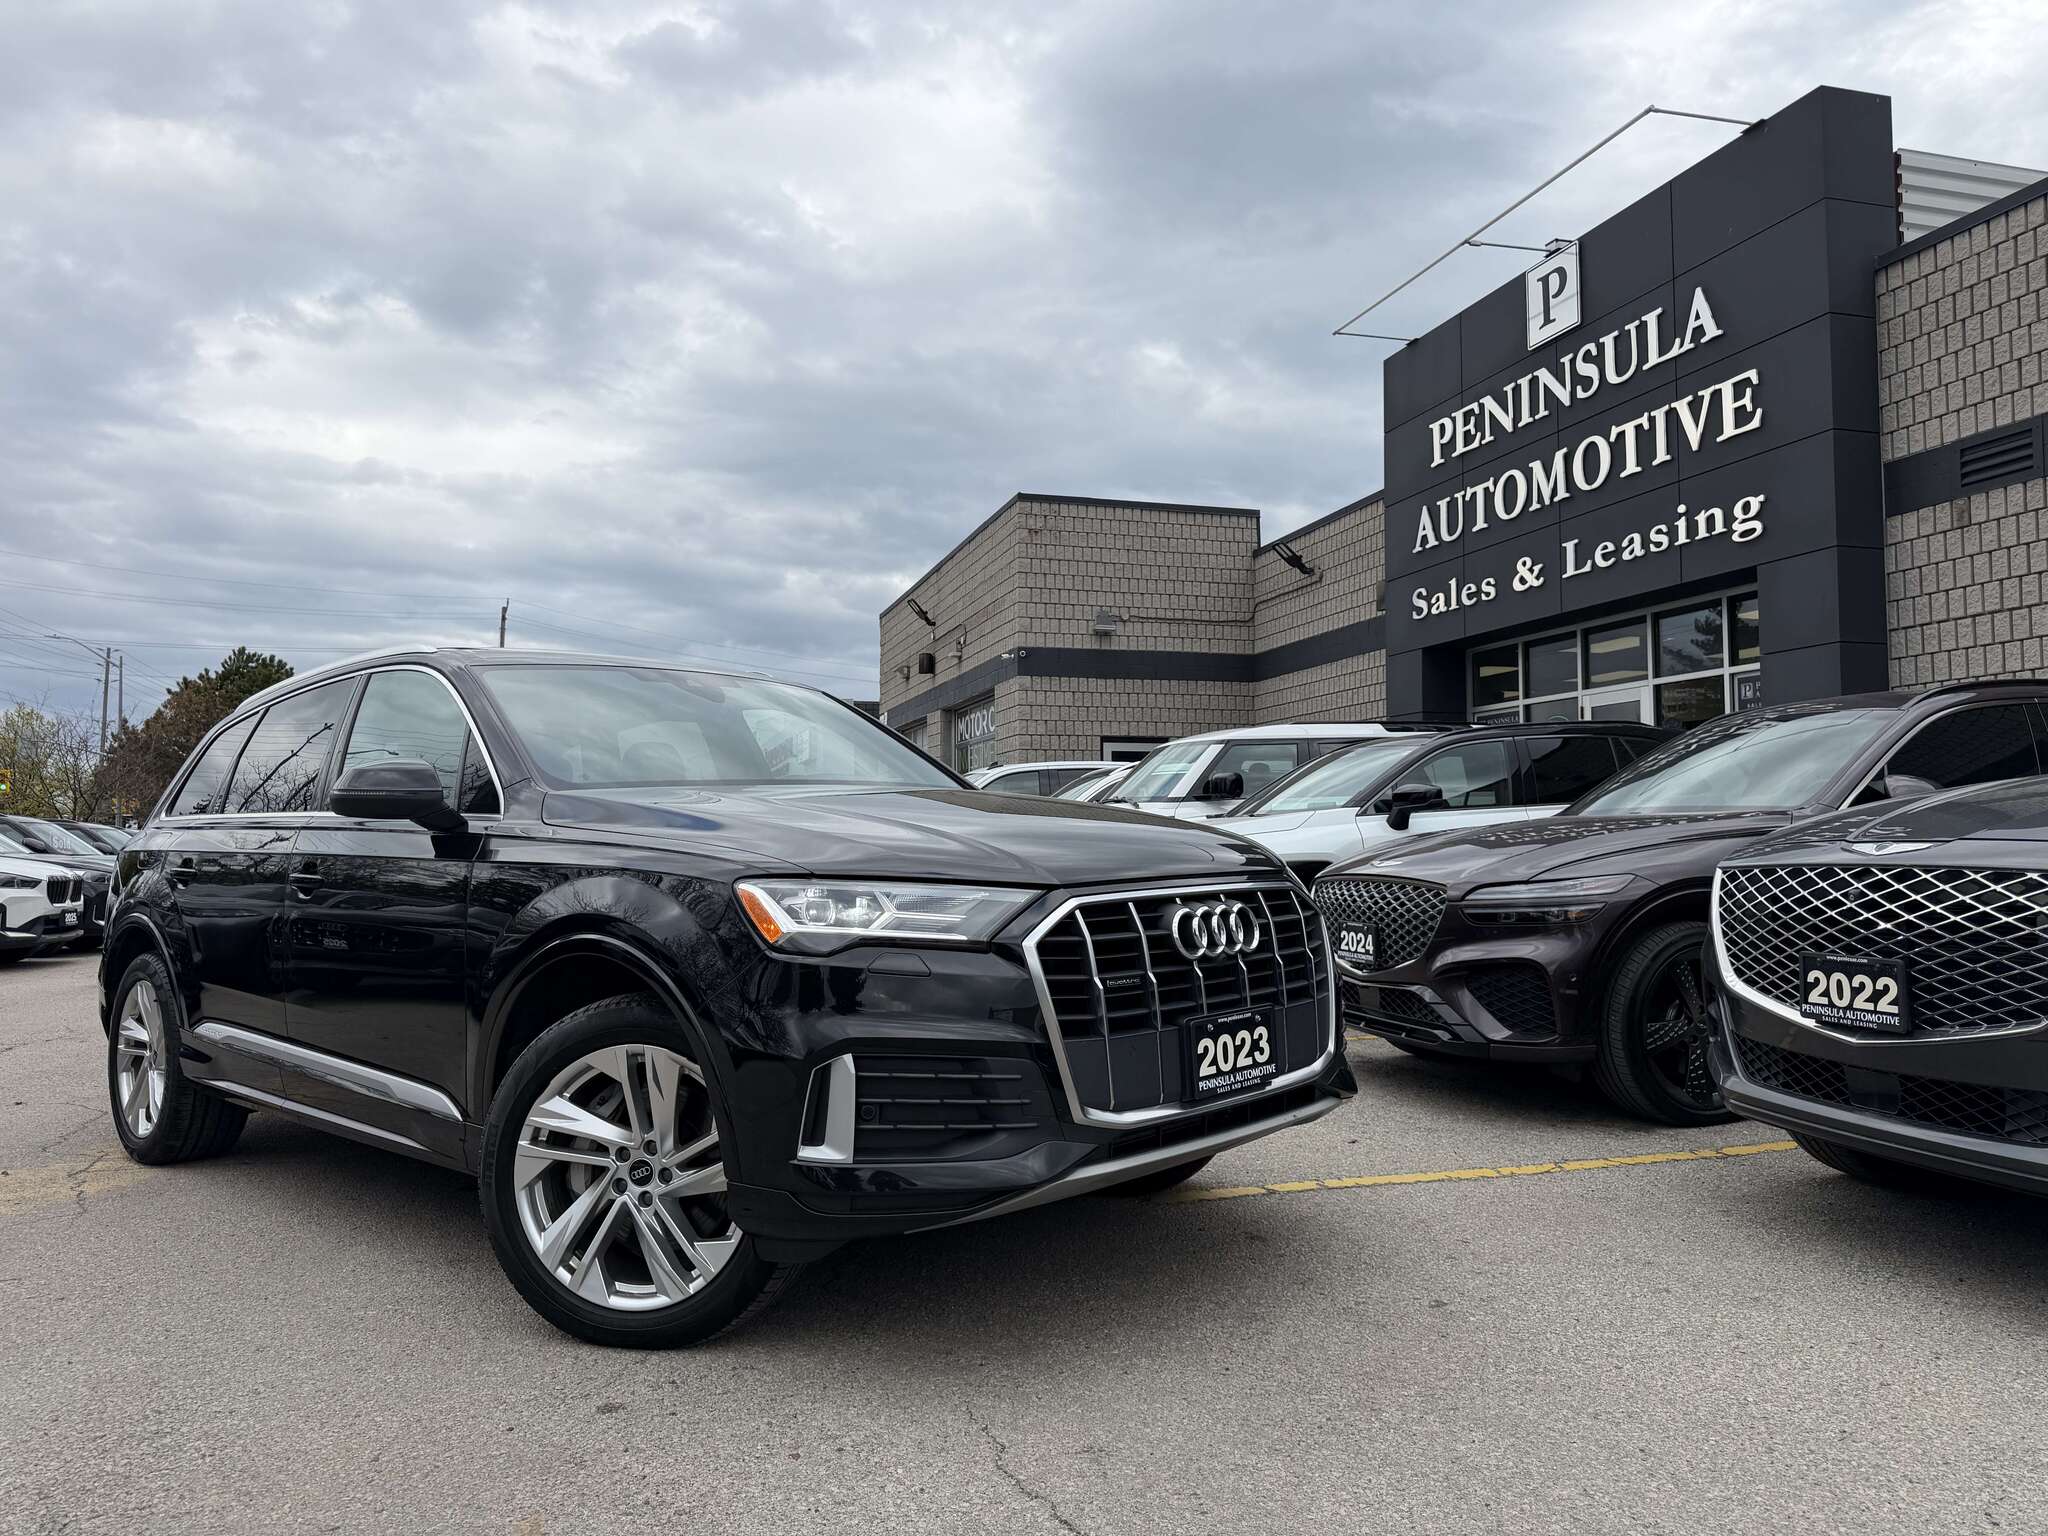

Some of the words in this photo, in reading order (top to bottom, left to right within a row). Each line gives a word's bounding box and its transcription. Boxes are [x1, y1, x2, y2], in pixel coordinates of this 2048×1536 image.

[1537, 266, 1568, 330] P
[1429, 287, 1723, 468] PENINSULA
[1412, 369, 1762, 553] AUTOMOTIVE
[1412, 576, 1497, 620] Sales
[1512, 556, 1544, 592] &
[1562, 495, 1765, 579] Leasing
[1341, 930, 1374, 955] 2024
[1802, 1003, 1844, 1017] PENINSULA
[1845, 1009, 1900, 1025] AUTOMOTIVE
[1807, 969, 1899, 1014] 2022
[1854, 1020, 1878, 1029] LEASING
[1197, 1025, 1271, 1078] 2023
[1198, 1073, 1235, 1092] PENINSULA
[1235, 1063, 1276, 1082] AUTOMOTIVE
[1217, 1085, 1231, 1094] SALES
[1232, 1082, 1242, 1090] AND
[1242, 1078, 1261, 1088] LEASING
